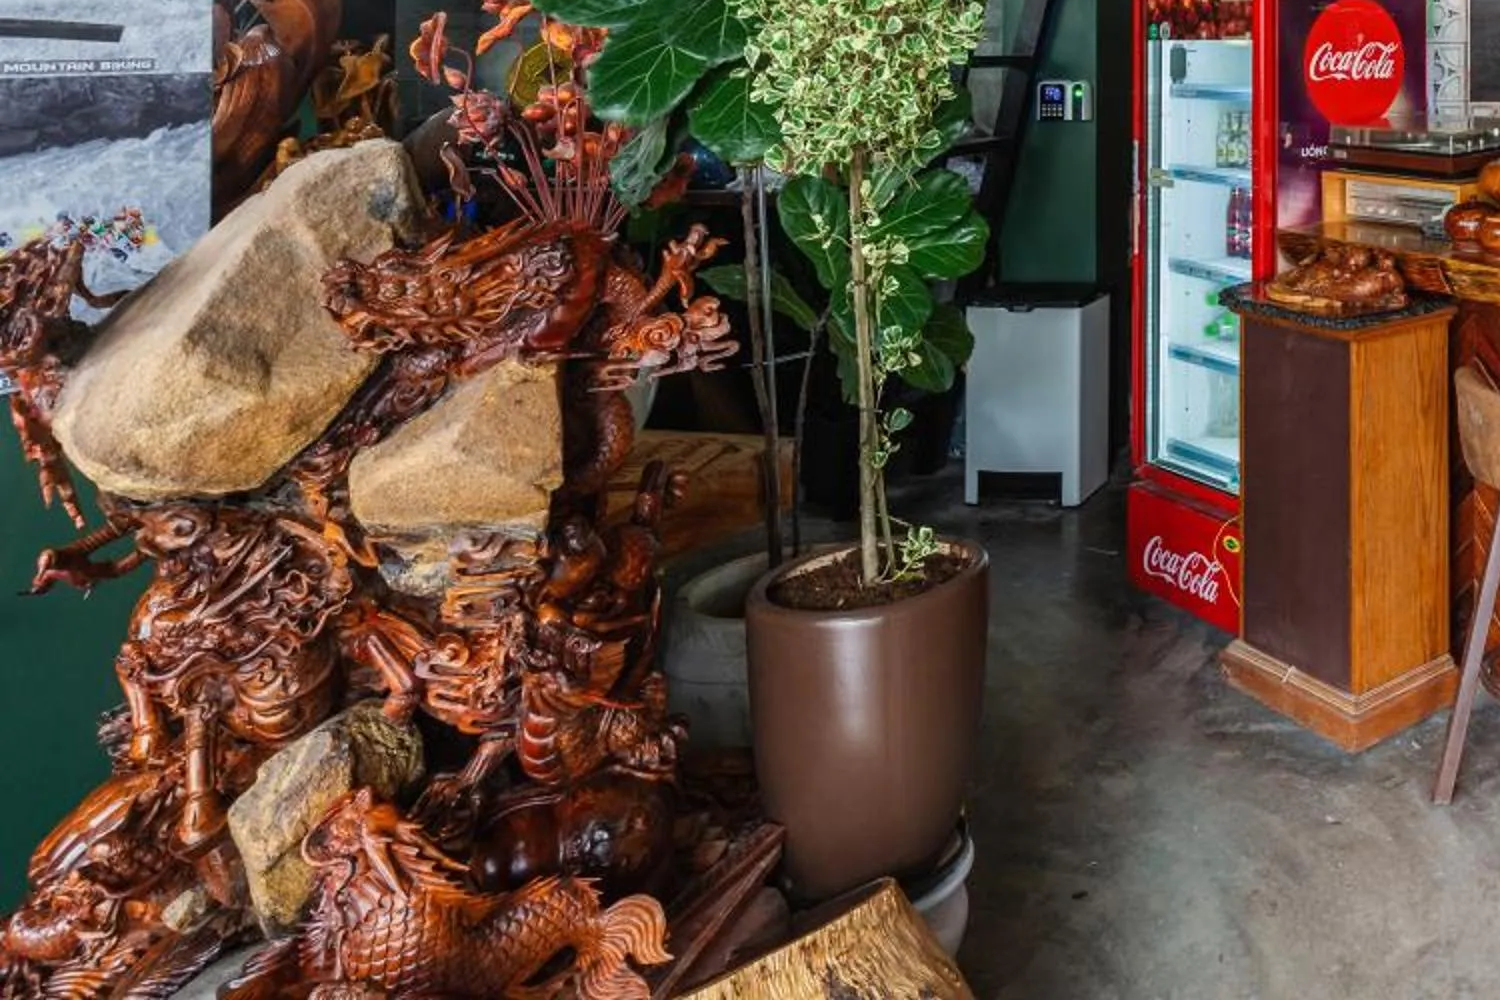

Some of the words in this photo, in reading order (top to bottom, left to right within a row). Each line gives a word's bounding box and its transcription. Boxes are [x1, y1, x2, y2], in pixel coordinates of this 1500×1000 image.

[3, 62, 95, 73] MOUNTAIN
[1309, 40, 1399, 82] Coca-Cola
[1143, 534, 1219, 605] Coca-Cola
